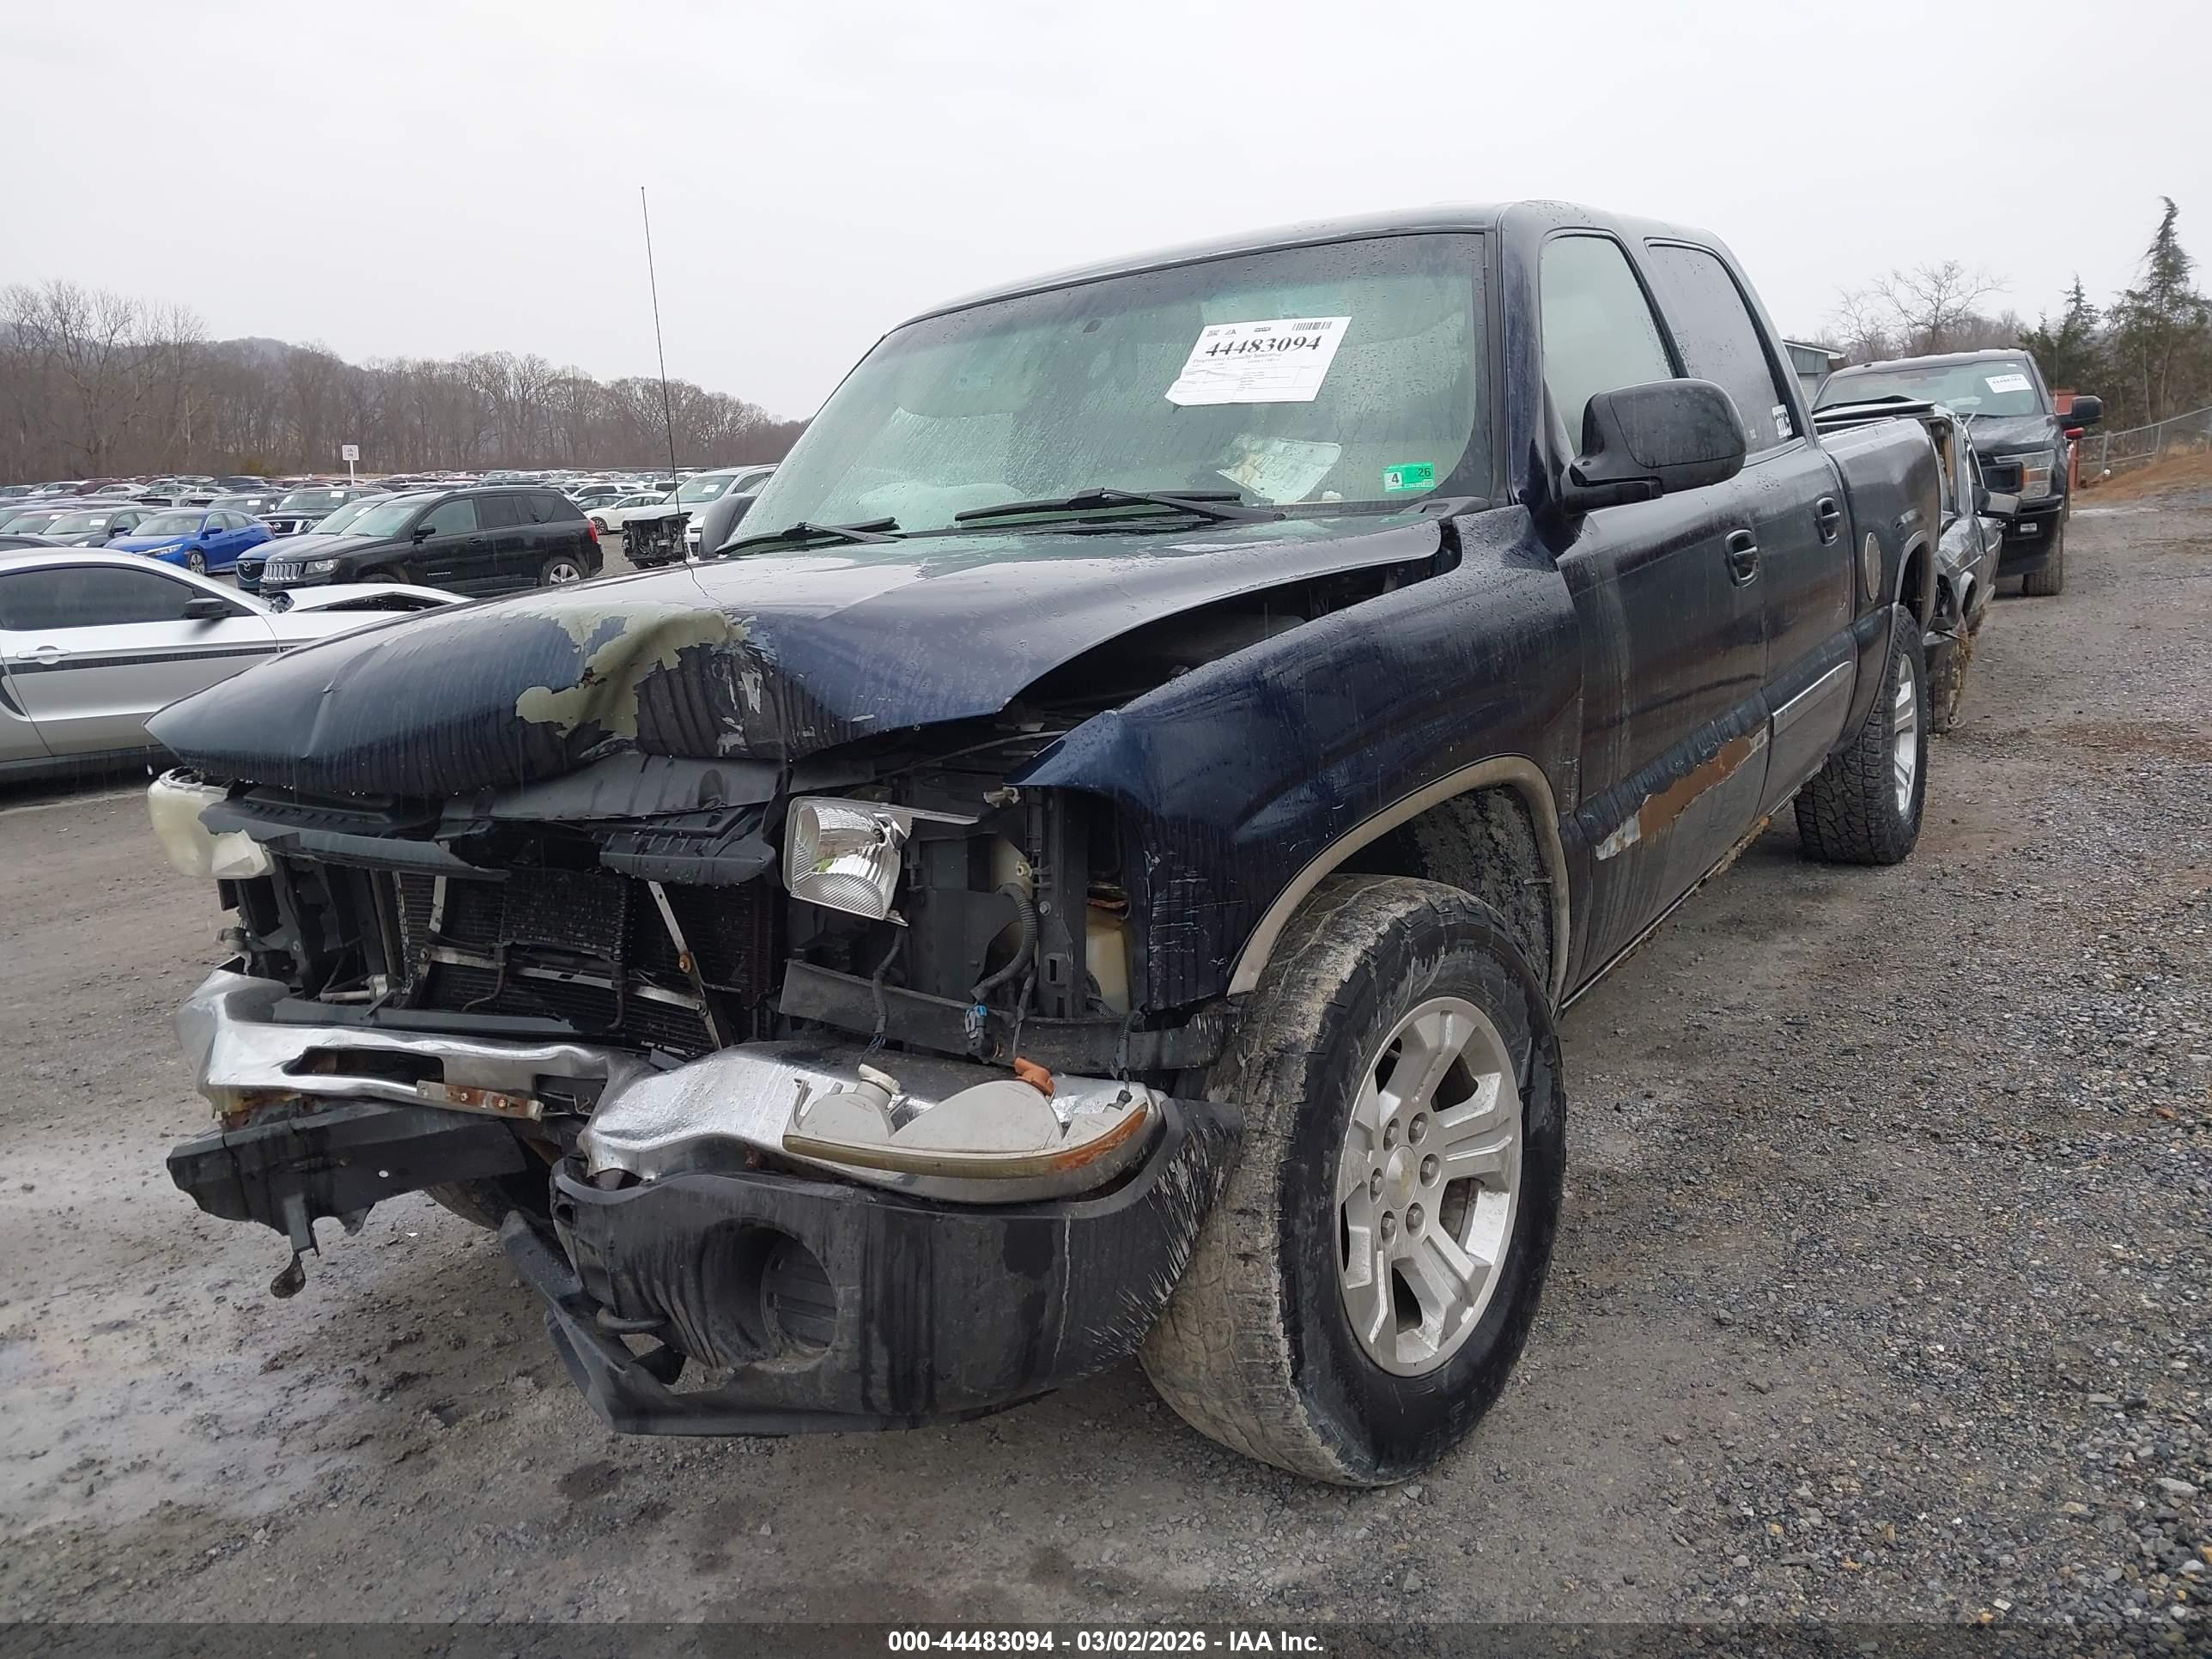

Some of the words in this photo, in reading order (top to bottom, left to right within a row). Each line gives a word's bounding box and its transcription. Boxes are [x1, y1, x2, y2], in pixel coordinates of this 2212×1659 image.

[1205, 335, 1322, 356] 44483094
[1418, 468, 1431, 477] 26
[1391, 473, 1400, 483] 4
